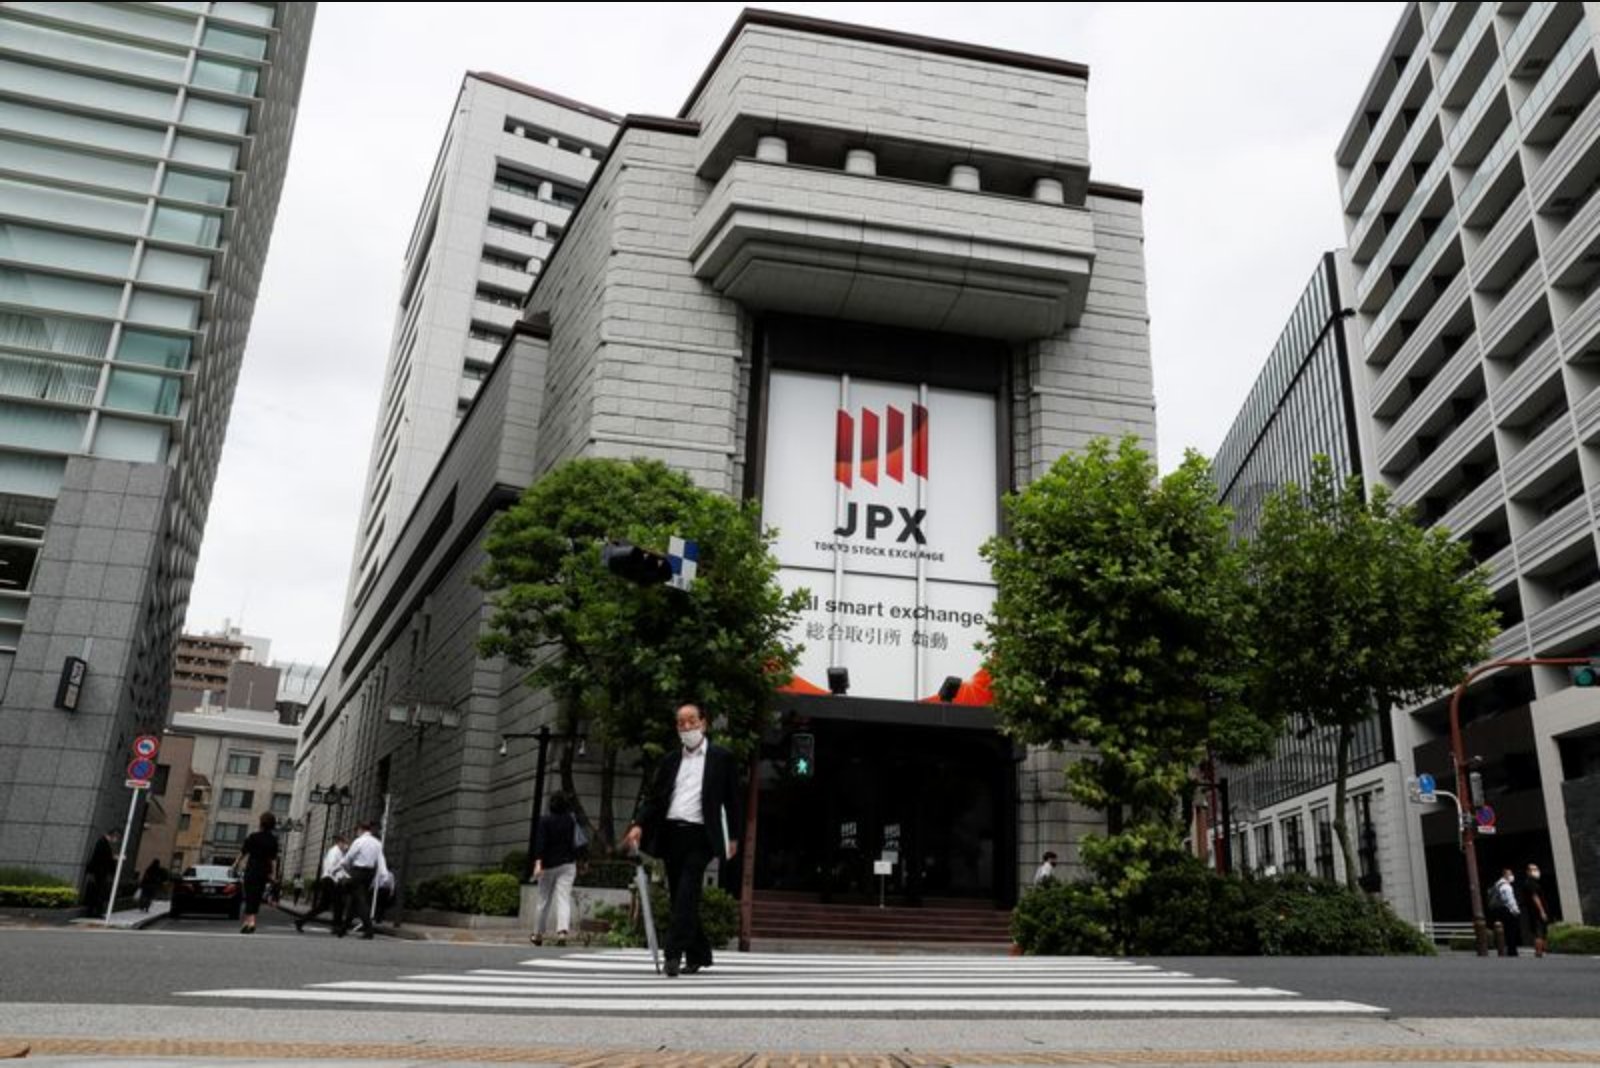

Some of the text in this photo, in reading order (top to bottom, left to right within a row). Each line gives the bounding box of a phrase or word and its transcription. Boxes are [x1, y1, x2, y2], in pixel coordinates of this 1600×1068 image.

[833, 502, 927, 545] JPX
[814, 541, 944, 562] TOKYO STOCK EXCHANGE
[825, 599, 883, 617] smart
[890, 604, 984, 628] exchange
